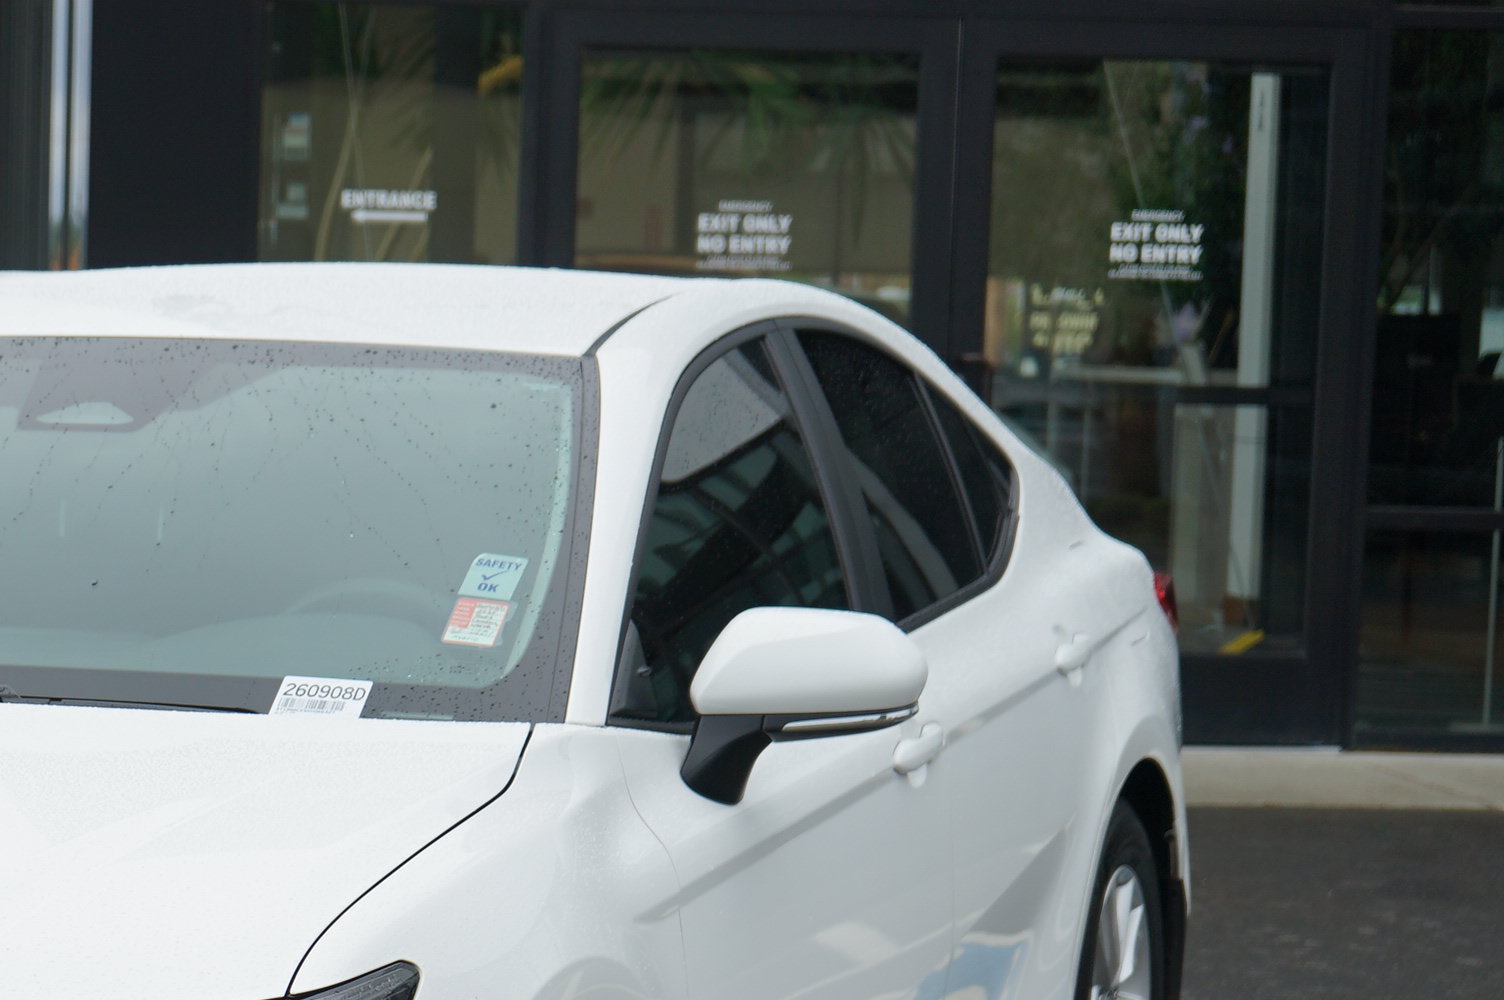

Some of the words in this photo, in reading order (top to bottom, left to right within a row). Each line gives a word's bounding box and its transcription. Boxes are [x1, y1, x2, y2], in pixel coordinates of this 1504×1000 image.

[341, 189, 438, 209] ENTRANCE
[698, 212, 741, 232] EXIT
[742, 213, 793, 234] ONLY
[1110, 221, 1153, 242] EXIT
[1155, 223, 1204, 243] ONLY
[697, 234, 726, 253] NO
[729, 234, 792, 255] ENTRY
[1109, 243, 1138, 263] NO
[1140, 243, 1203, 265] ENTRY
[476, 558, 521, 570] SAFETY
[477, 582, 499, 592] OK
[283, 683, 366, 701] 260908D
